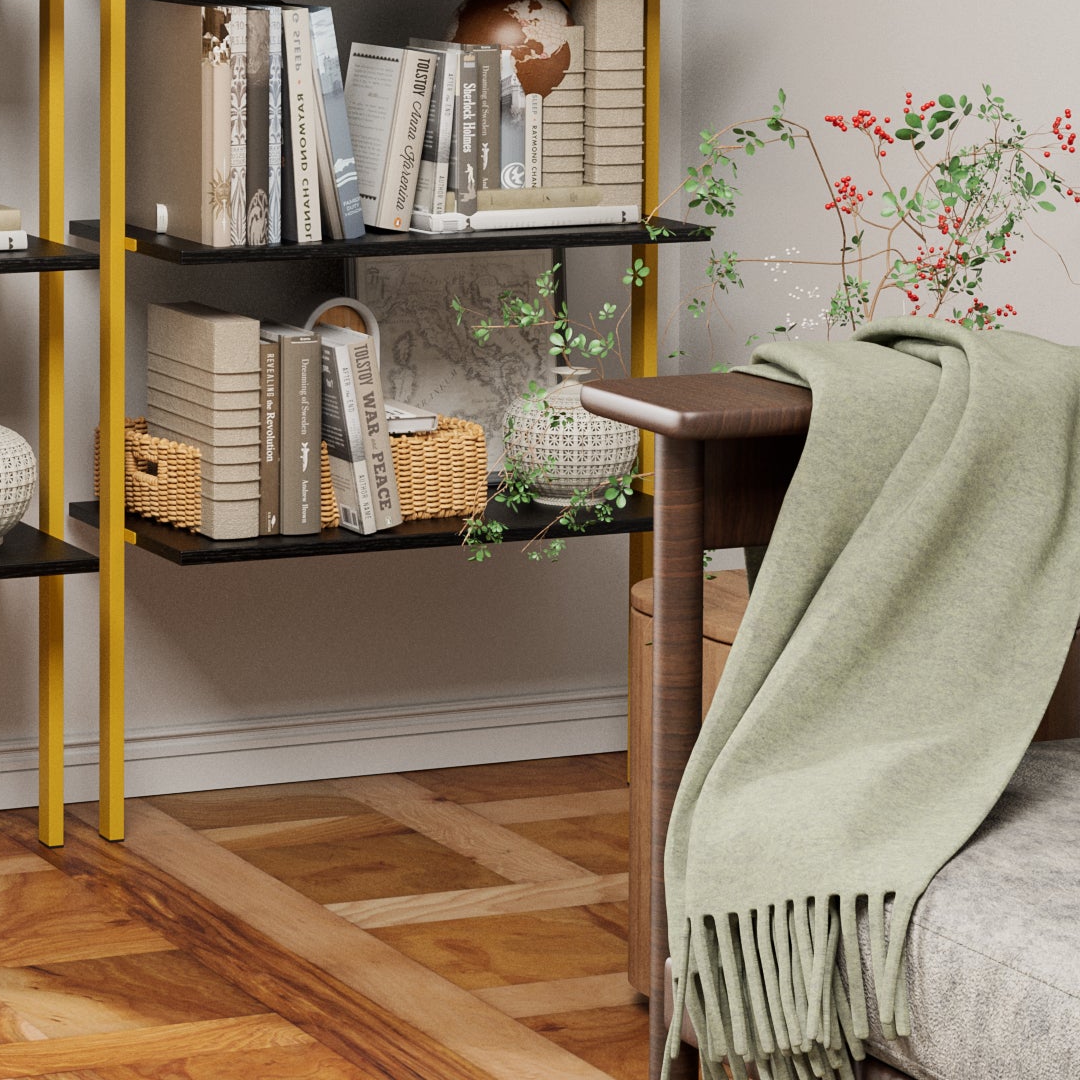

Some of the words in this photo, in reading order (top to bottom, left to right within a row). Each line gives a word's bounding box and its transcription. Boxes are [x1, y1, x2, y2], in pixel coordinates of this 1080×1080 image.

[412, 58, 431, 97] TOLSTOY
[480, 65, 489, 99] Dreaming
[463, 83, 477, 118] Sherlock
[408, 101, 422, 141] Anna
[462, 122, 477, 153] Holmes
[481, 108, 489, 136] Sweden
[395, 145, 417, 212] Karenina
[266, 353, 275, 397] REVEALING
[300, 358, 309, 396] Dreaming
[354, 343, 374, 386] TOLSTOY
[266, 399, 274, 410] the
[301, 397, 309, 405] of
[362, 390, 380, 437] WAR
[266, 412, 276, 462] Revolution
[301, 405, 309, 435] Sweden
[359, 474, 368, 498] AUTHOR
[372, 450, 392, 511] PEACE
[362, 502, 372, 519] NAME
